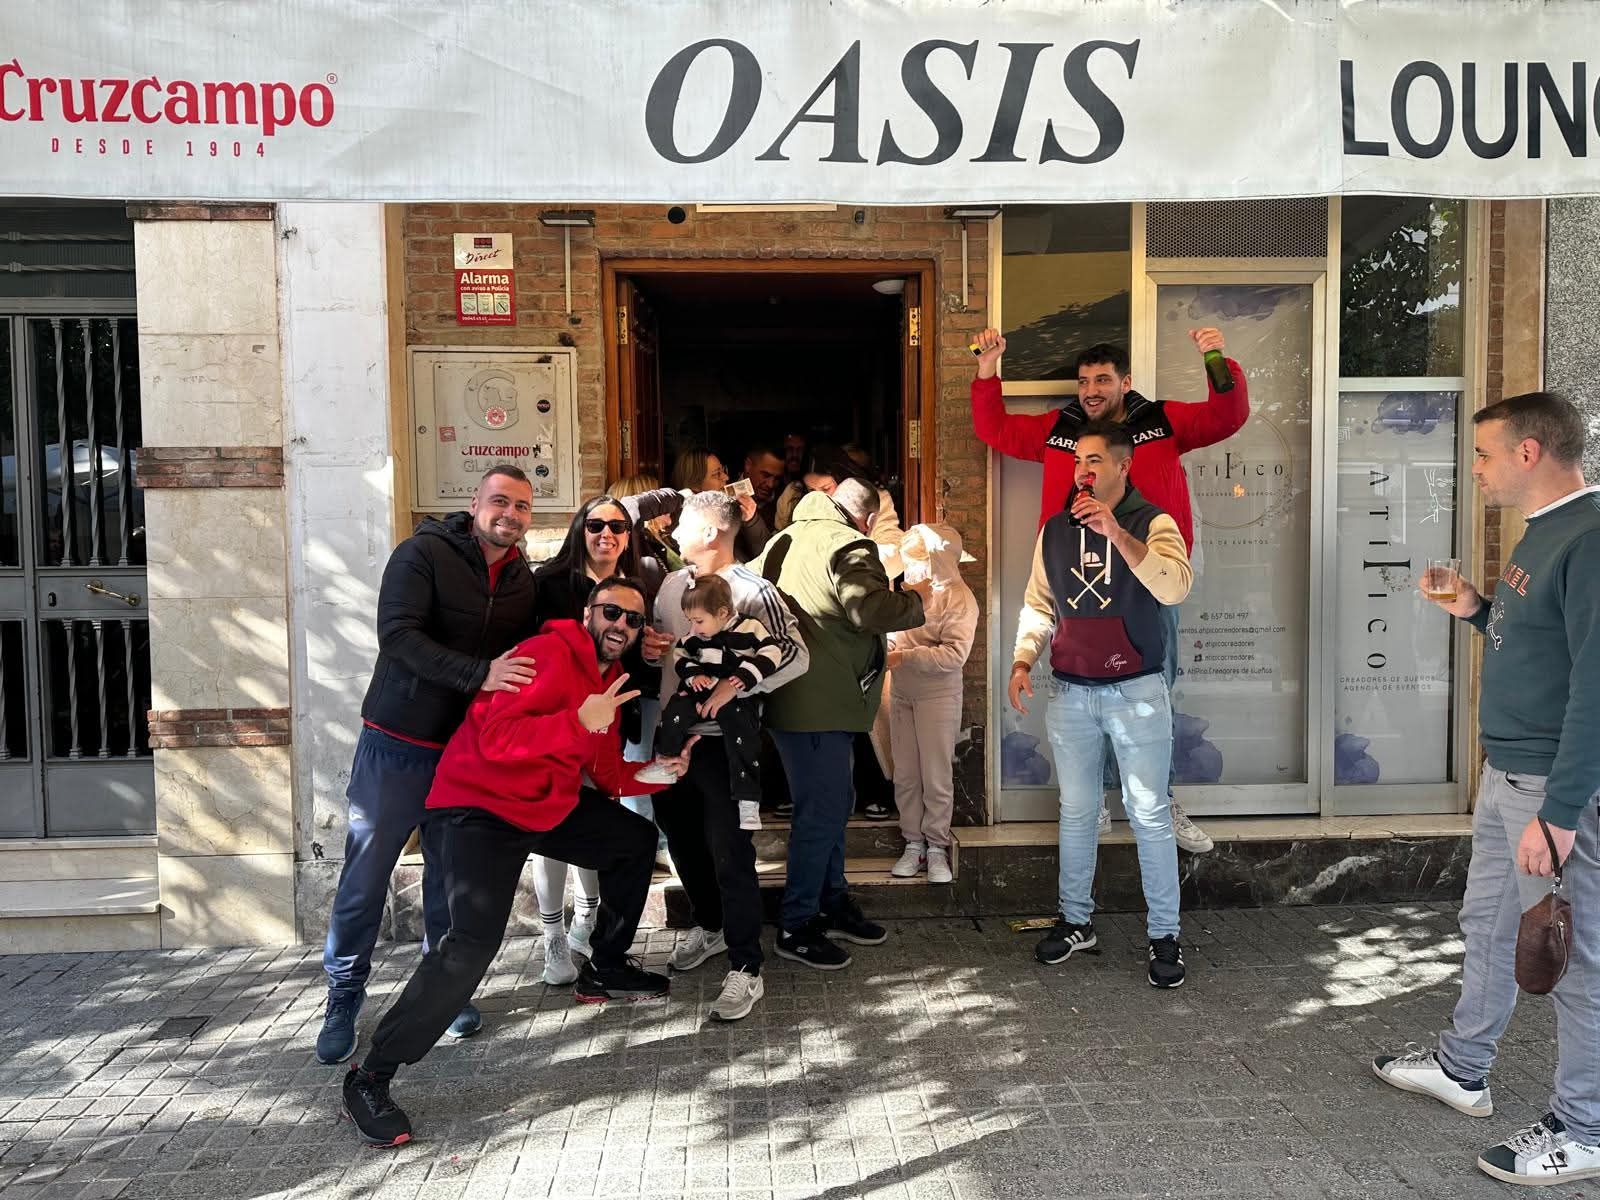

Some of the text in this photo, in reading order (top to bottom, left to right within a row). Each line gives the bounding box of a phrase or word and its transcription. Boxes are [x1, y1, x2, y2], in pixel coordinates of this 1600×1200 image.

[645, 38, 1141, 166] OASIS
[1340, 59, 1600, 160] LOUN
[51, 137, 265, 158] DESDE 1904
[466, 249, 502, 264] Direct
[460, 272, 509, 284] Alarma
